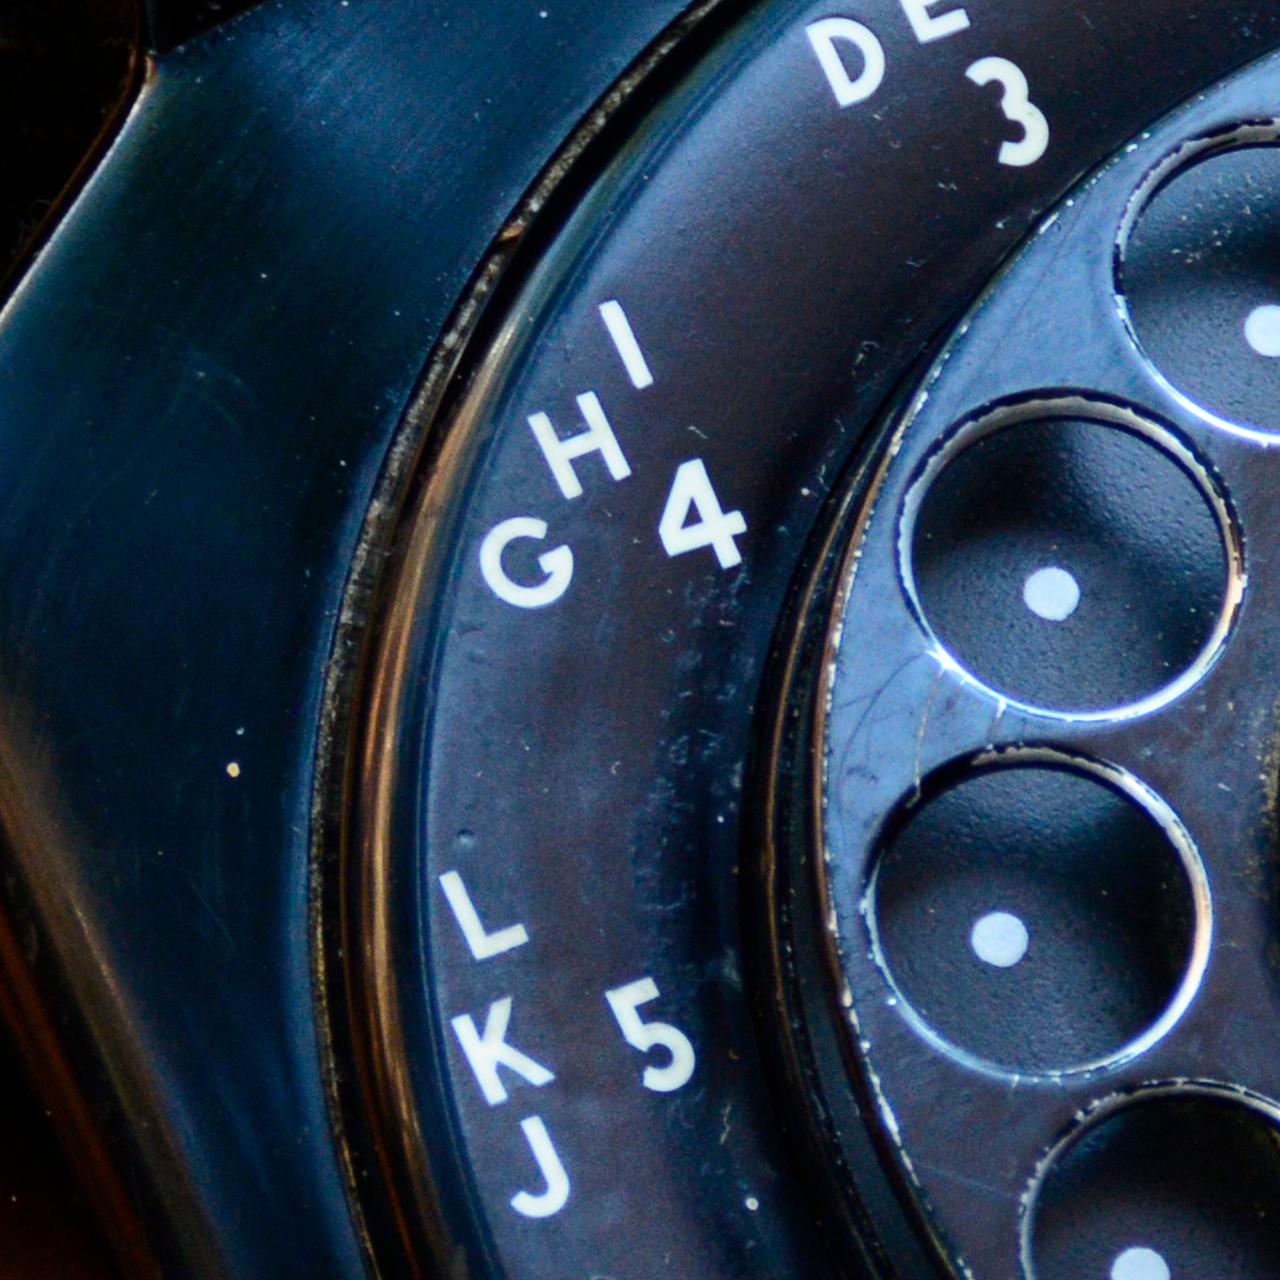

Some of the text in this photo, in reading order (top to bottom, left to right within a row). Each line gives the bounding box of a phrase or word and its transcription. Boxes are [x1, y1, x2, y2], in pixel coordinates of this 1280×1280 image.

[964, 56, 1050, 167] 3
[657, 457, 749, 570] 4
[604, 976, 696, 1093] 5
